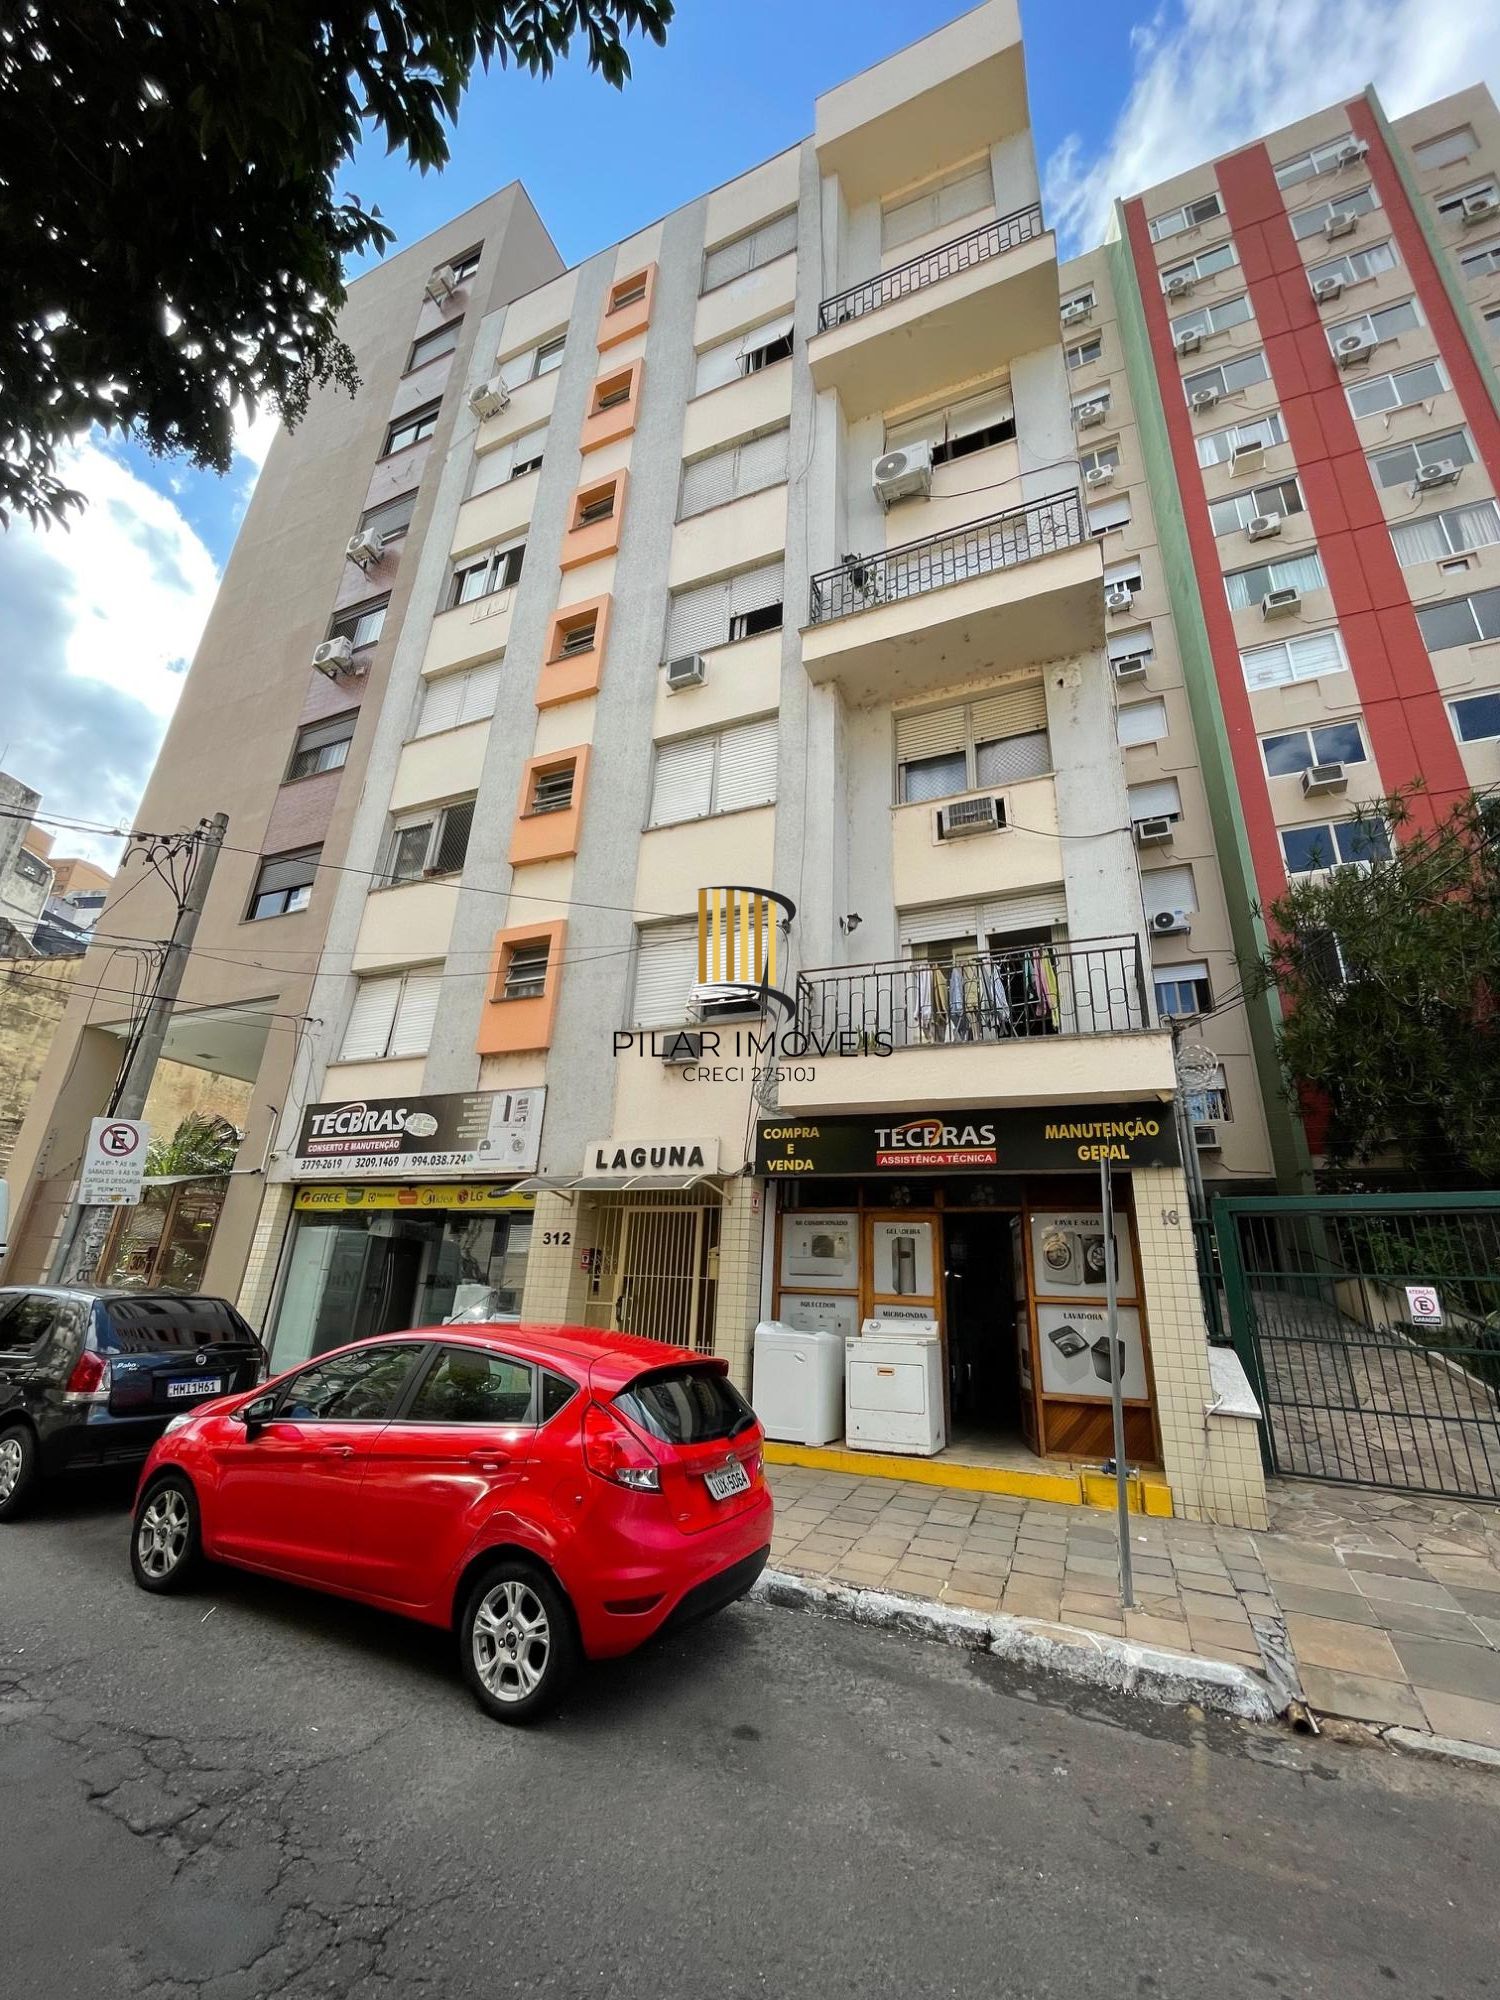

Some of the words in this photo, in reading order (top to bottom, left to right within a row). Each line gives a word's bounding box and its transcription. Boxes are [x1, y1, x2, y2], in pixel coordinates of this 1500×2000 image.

[311, 1106, 407, 1136] TECBRAS
[763, 1126, 820, 1140] COMPRA
[874, 1122, 996, 1148] TECBRAS
[1045, 1117, 1160, 1141] MANUTENÇÃO
[308, 1143, 343, 1153] CONSERTO
[343, 1143, 350, 1152] E
[350, 1139, 400, 1151] MANUTENÇÃO
[787, 1144, 795, 1155] E
[1077, 1144, 1130, 1160] GERAL
[301, 1158, 342, 1170] 3779-2619
[355, 1156, 399, 1168] 3209.1469
[411, 1154, 467, 1167] 994.038.724
[595, 1146, 704, 1169] LAGUNA
[946, 1153, 993, 1164] TÉCNICA
[767, 1159, 815, 1172] VENDA
[311, 1193, 342, 1202] GREE
[470, 1191, 483, 1201] LG
[543, 1232, 571, 1245] 312
[883, 1311, 928, 1319] MICRO-ONDAS
